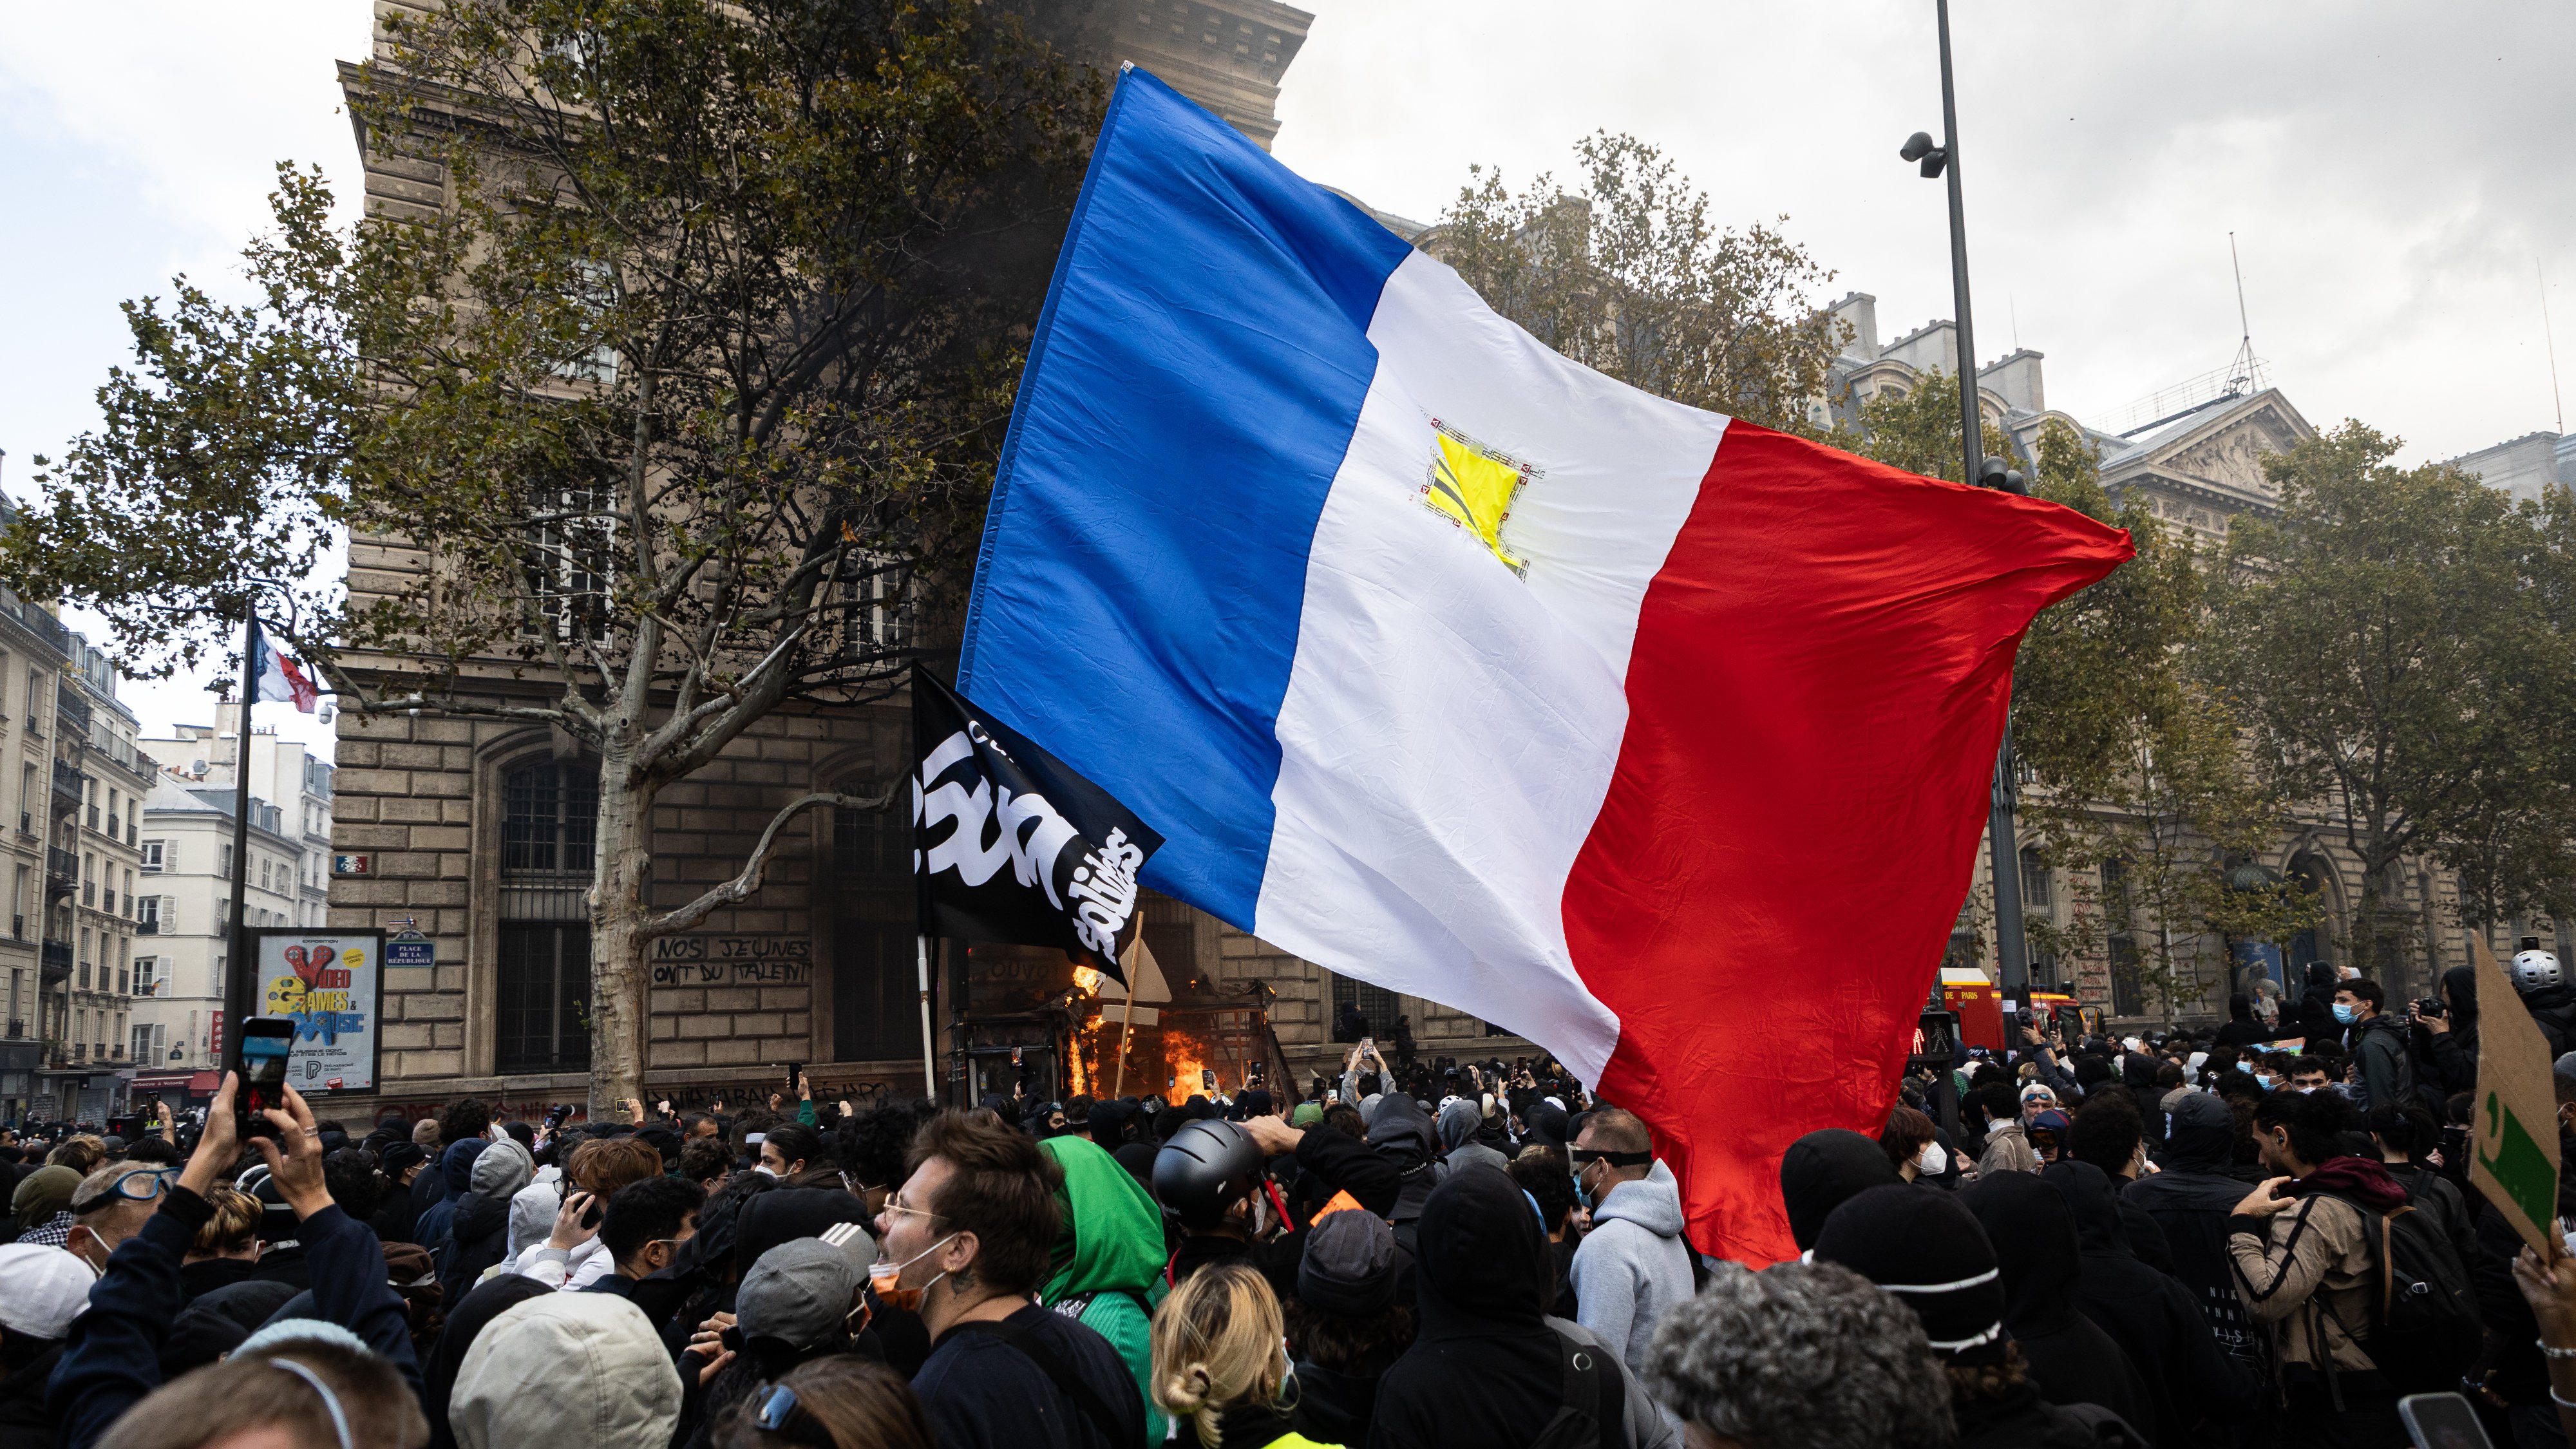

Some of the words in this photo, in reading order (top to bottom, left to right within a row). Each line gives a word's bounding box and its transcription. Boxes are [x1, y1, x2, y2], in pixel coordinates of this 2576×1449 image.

[657, 938, 702, 958] NOS
[719, 938, 811, 958] JEUNES
[284, 945, 351, 989] VIDEO
[654, 965, 694, 983] ONT
[701, 965, 723, 981] DU
[733, 962, 814, 983] TALENT
[266, 976, 348, 1016] GAMES
[350, 1001, 356, 1010] &
[287, 1011, 365, 1046] MUSIC
[2210, 1286, 2237, 1300] NIK
